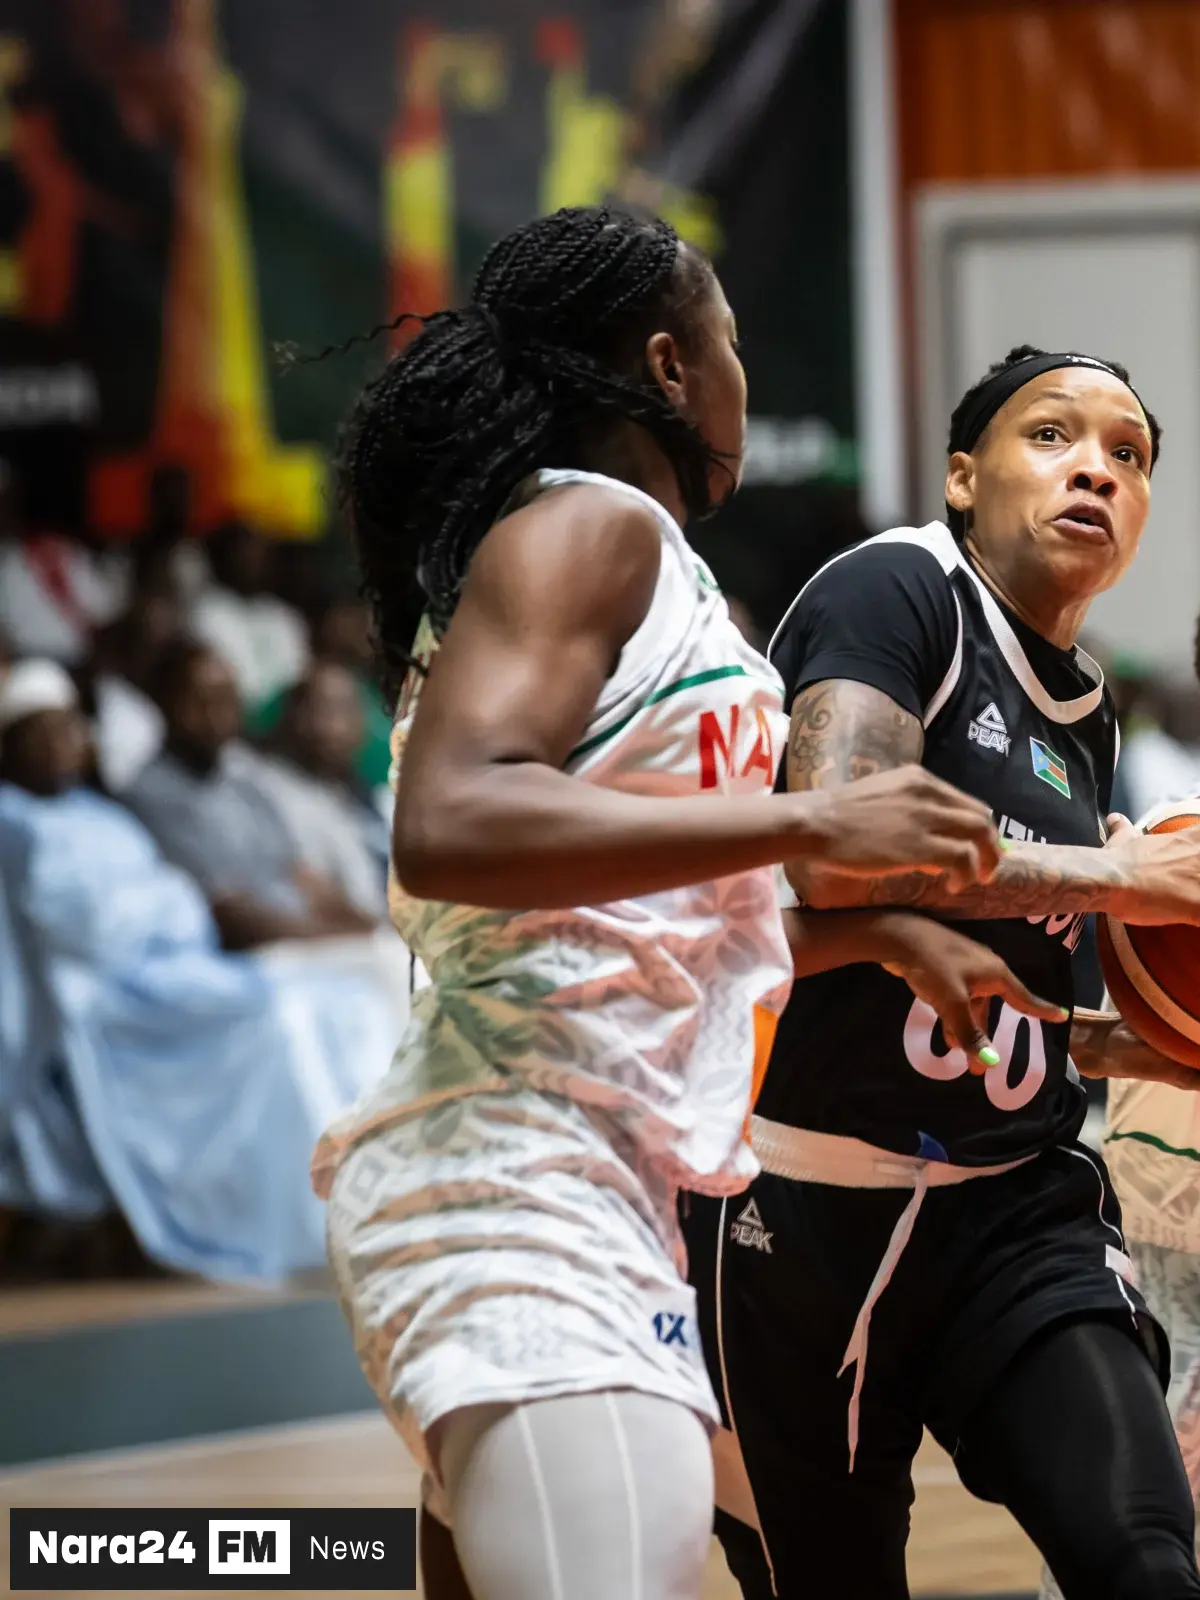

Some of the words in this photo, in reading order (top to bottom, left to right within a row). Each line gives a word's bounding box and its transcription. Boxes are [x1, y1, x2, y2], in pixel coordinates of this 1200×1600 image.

[967, 720, 1011, 757] PEAK
[731, 1222, 774, 1254] PEAK
[653, 1312, 687, 1347] 1X
